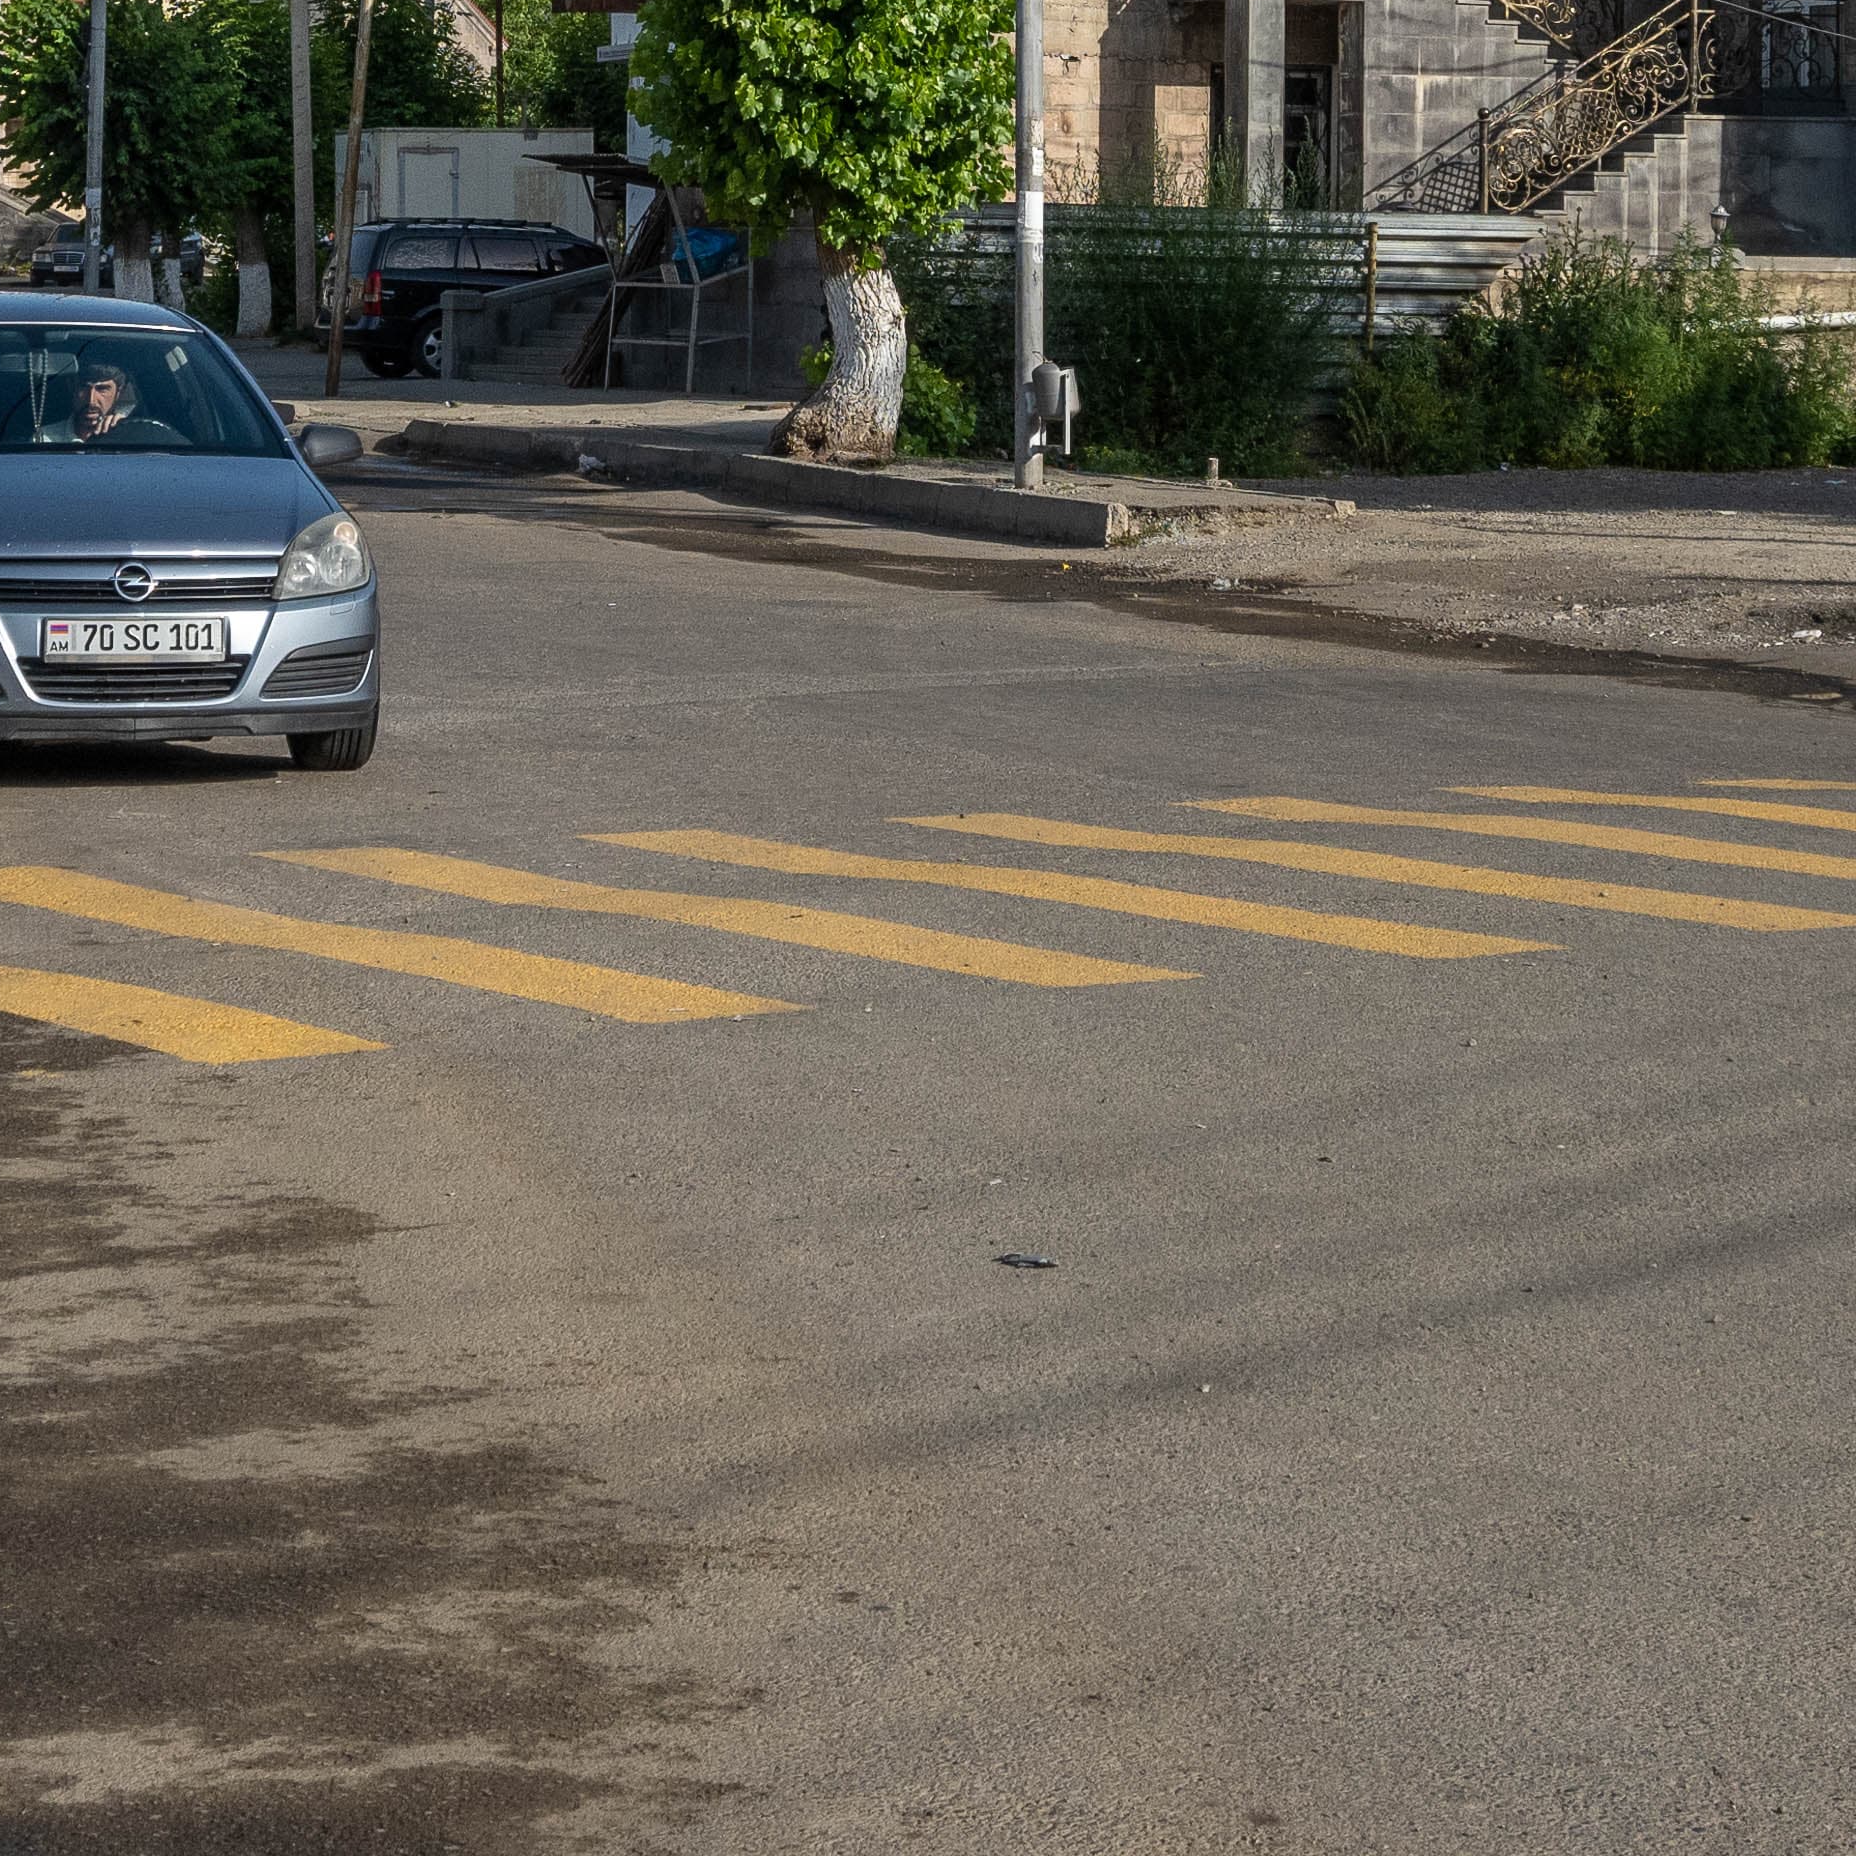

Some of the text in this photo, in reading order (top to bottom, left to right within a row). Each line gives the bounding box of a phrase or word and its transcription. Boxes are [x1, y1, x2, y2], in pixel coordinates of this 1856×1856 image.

[49, 624, 215, 652] AM 70 SC 101
